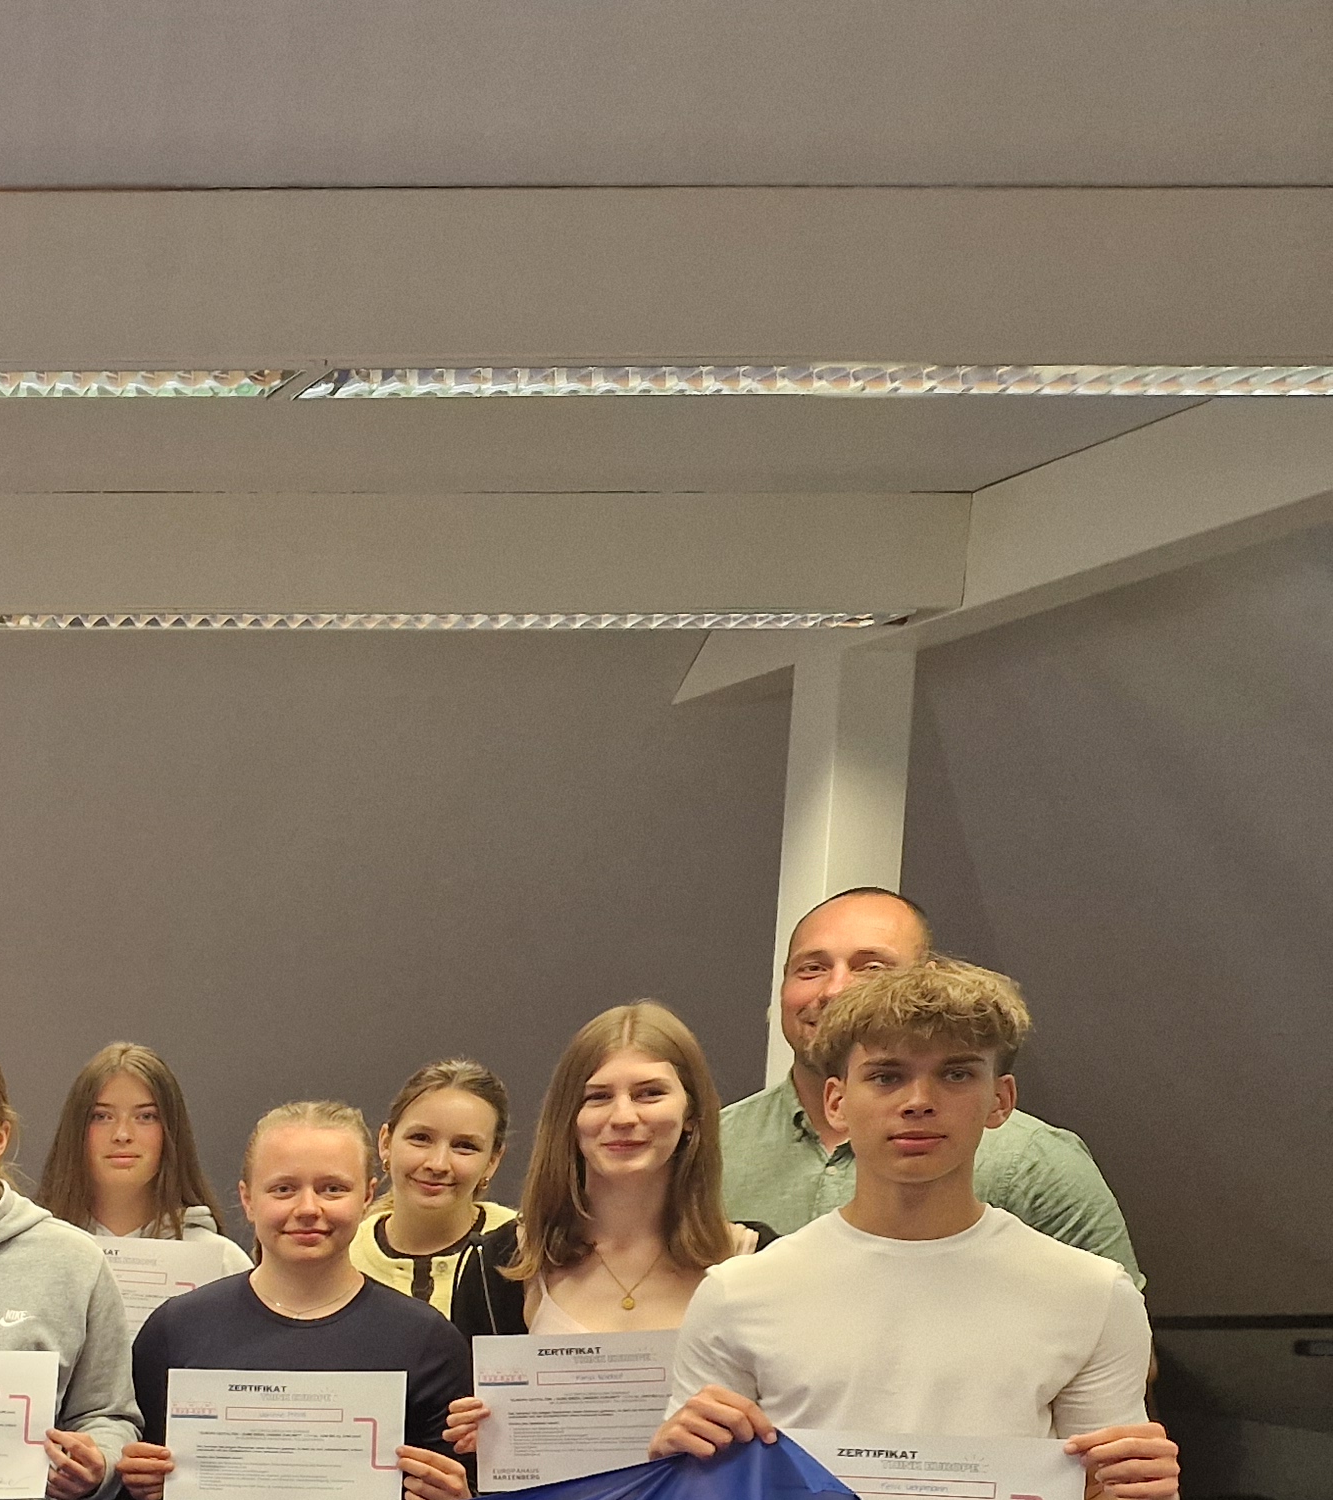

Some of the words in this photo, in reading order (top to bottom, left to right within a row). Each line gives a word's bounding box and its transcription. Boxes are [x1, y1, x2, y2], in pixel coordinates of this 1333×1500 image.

[4, 1309, 28, 1320] NIKE
[537, 1346, 601, 1356] ZERTIFIKAT
[228, 1384, 287, 1393] ZERTIFIKAT
[837, 1448, 918, 1459] ZERTIFIKAT
